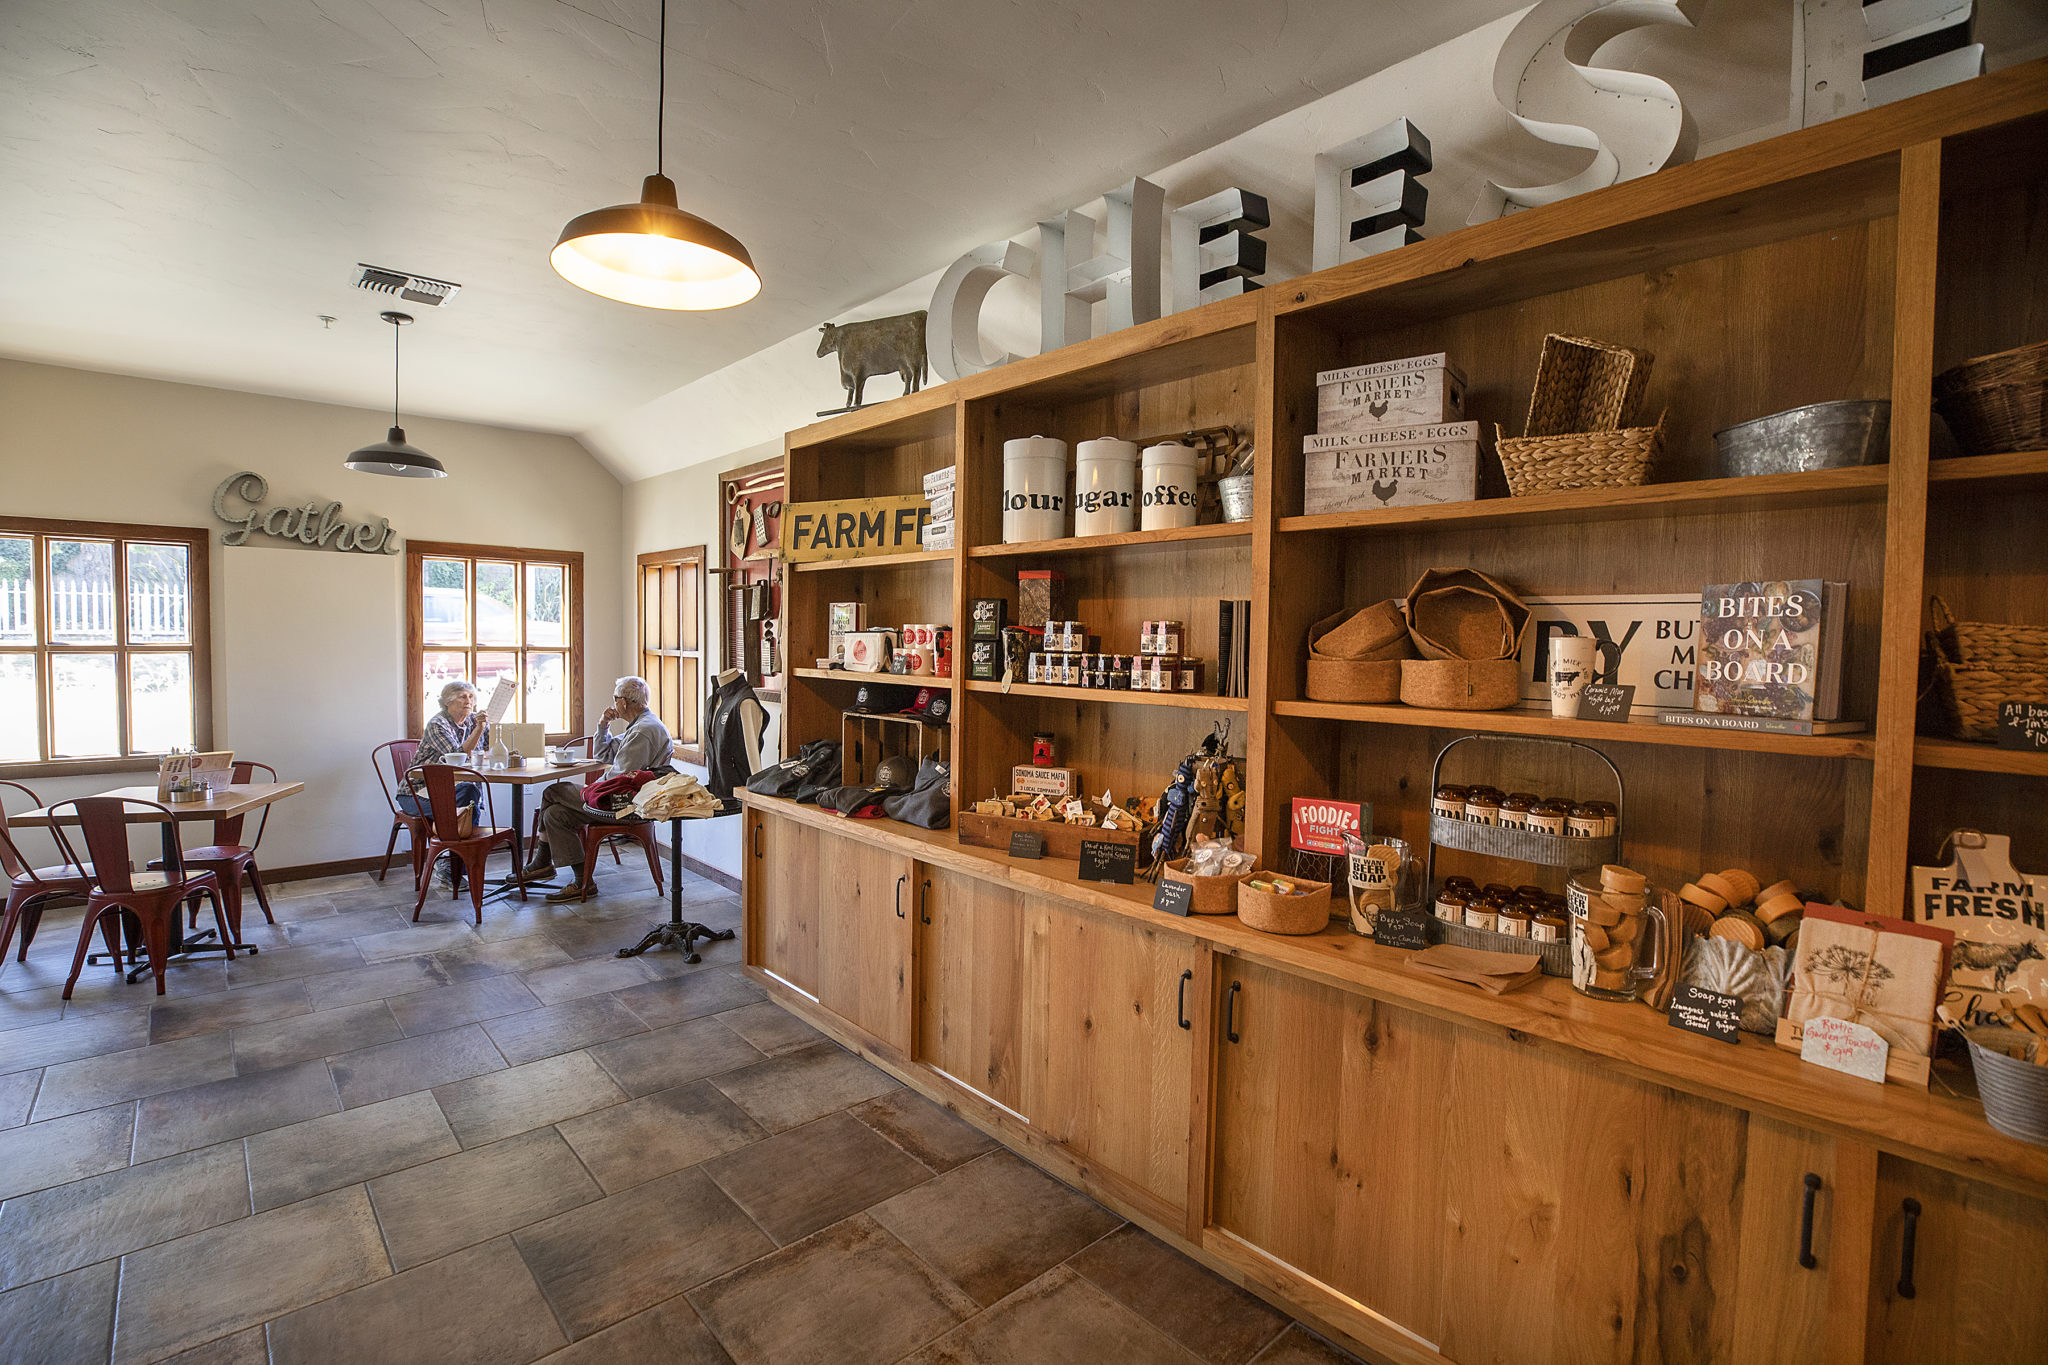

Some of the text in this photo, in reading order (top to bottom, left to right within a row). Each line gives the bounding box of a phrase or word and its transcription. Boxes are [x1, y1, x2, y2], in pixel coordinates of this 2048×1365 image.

[1322, 356, 1439, 382] MILK CHEESE EGGS
[1340, 370, 1426, 396] FARMERS
[1353, 389, 1412, 407] MARKET
[1312, 425, 1469, 449] MILK CHEESE EGGS
[1335, 444, 1447, 469] FARMERS
[1351, 466, 1429, 485] MARKET
[213, 471, 400, 555] Gather
[793, 510, 886, 550] FARM
[1717, 595, 1804, 619] BITES
[1656, 620, 1700, 640] BU
[1723, 629, 1793, 651] ON A
[1706, 661, 1808, 685] BOARD
[2004, 704, 2022, 717] All
[1665, 715, 1694, 725] BITES
[1695, 717, 1713, 726] ON
[1713, 719, 1721, 727] A
[1722, 719, 1760, 729] BOARD
[1015, 769, 1066, 781] SONOMA SAUCE MAFIA
[1037, 787, 1061, 795] COMPANIES
[1299, 805, 1352, 830] FOODIE
[1309, 824, 1341, 837] FIGHT
[1353, 862, 1385, 875] BEER
[1363, 858, 1386, 867] WANT
[1352, 870, 1387, 884] SOAP
[1924, 893, 2045, 931] FRESH
[1688, 988, 1715, 1004] Soap
[1805, 1027, 1839, 1042] Garden
[1822, 1018, 1854, 1035] Rustic
